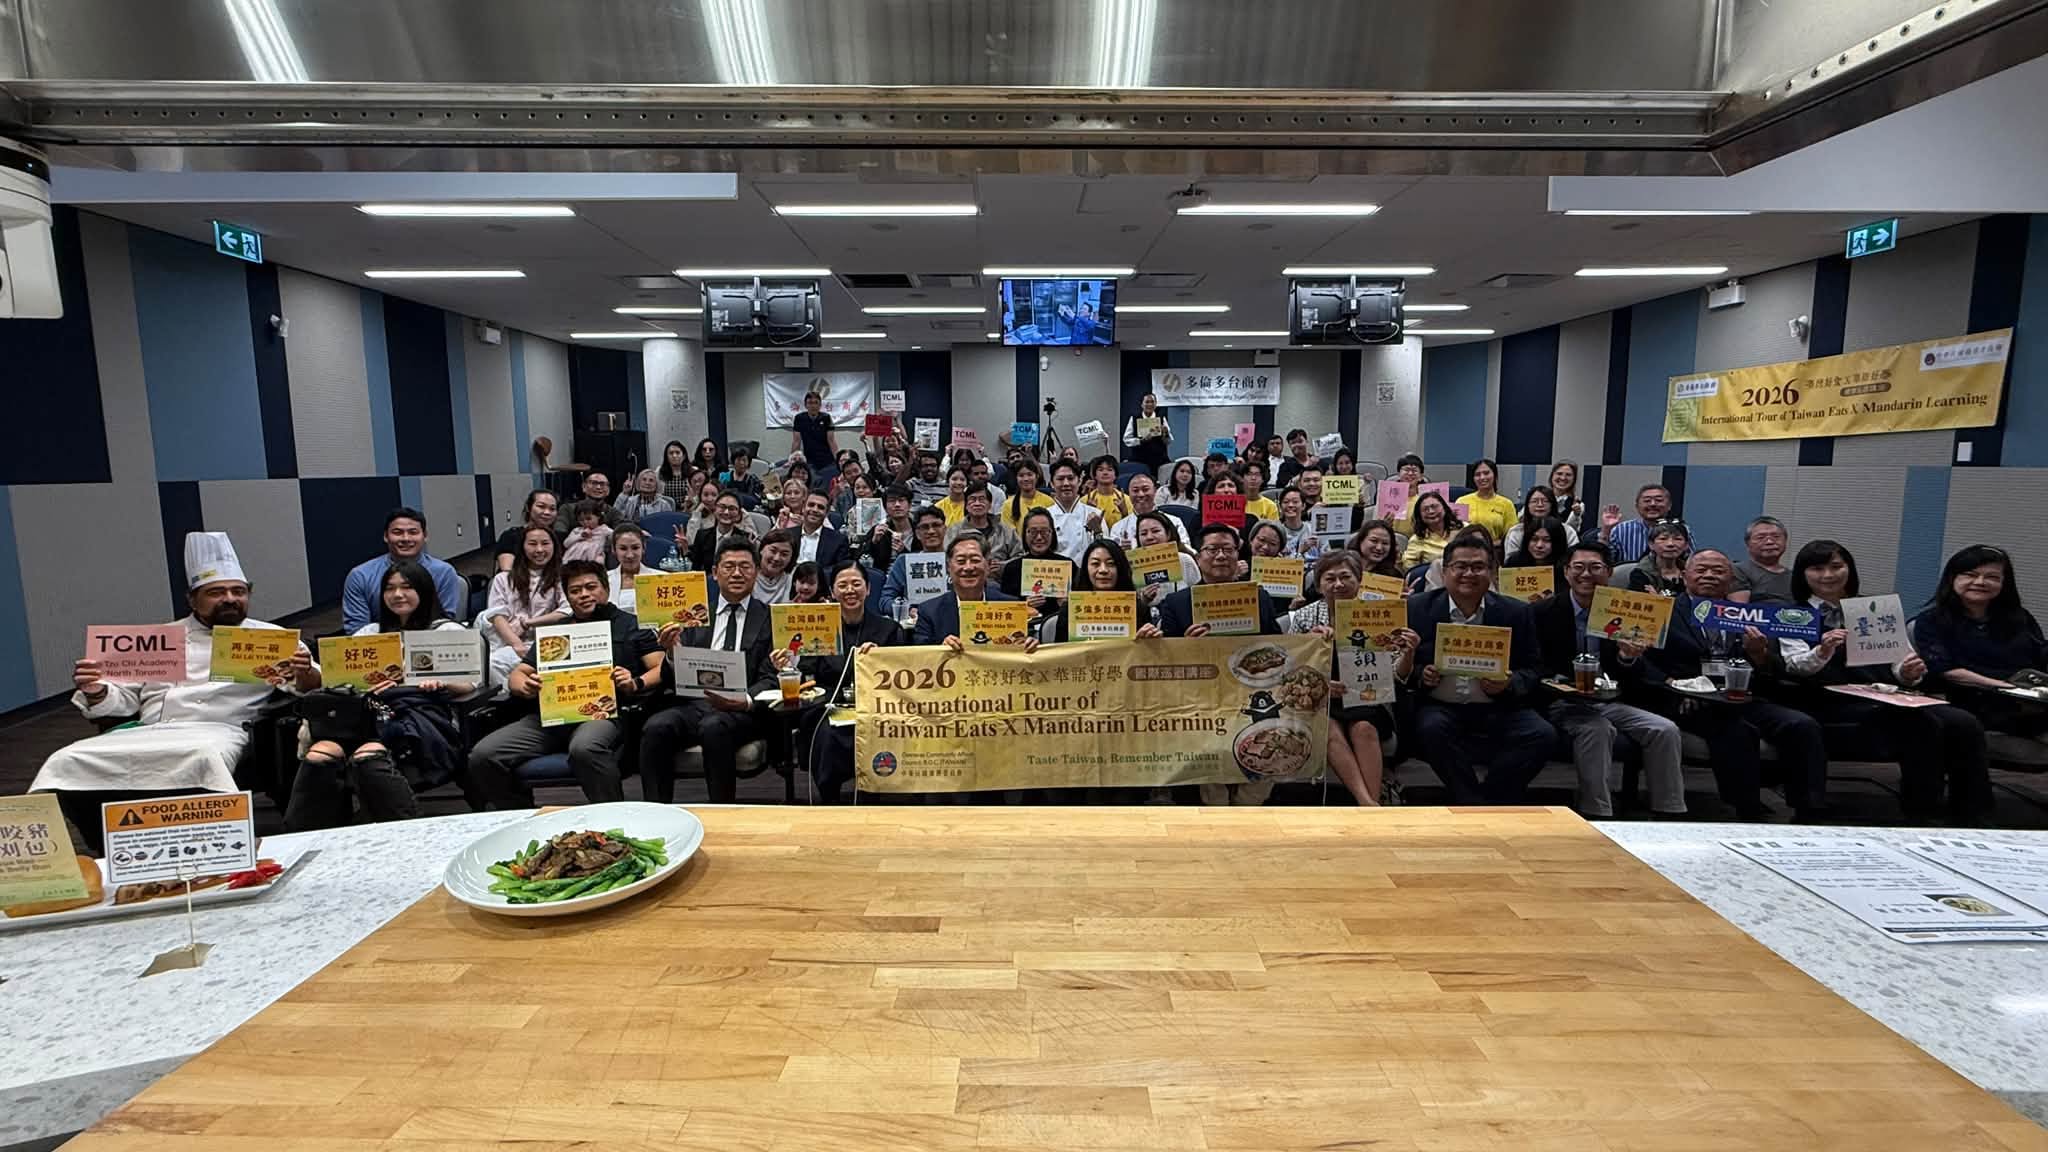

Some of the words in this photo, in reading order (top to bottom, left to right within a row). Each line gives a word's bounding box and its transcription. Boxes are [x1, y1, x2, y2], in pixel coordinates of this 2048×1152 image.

[1185, 375, 1268, 389] 多倫多台商會
[882, 393, 902, 401] TCML
[1741, 378, 1800, 407] 2026
[1701, 411, 1754, 425] International
[1756, 411, 1778, 423] Tour
[1779, 411, 1788, 421] of
[1791, 408, 1826, 422] Taiwan
[1828, 406, 1849, 418] Eats
[1850, 404, 1859, 415] X
[1862, 397, 1923, 414] Mandarin
[1926, 391, 1988, 411] Learning
[954, 430, 977, 439] TCML
[1077, 423, 1099, 434] TCML
[1210, 441, 1233, 449] TCML
[1325, 479, 1355, 489] TCML
[1207, 499, 1241, 511] TCML
[910, 561, 943, 579] 喜歡
[1146, 571, 1167, 581] TCML
[1516, 576, 1538, 586] 好吃
[657, 585, 686, 600] 好吃
[1074, 605, 1132, 614] 多倫多台商會
[1610, 598, 1654, 612] 台灣最棒
[787, 614, 826, 624] 台灣最棒
[976, 610, 1013, 620] 台灣好食
[1352, 610, 1391, 618] 台灣好食
[1713, 604, 1770, 623] TCML
[1854, 614, 1897, 637] 臺灣
[95, 634, 177, 653] TCML
[232, 642, 280, 653] 再來一碗
[344, 648, 378, 662] 好吃
[138, 658, 178, 667] Academy
[106, 669, 132, 677] North
[135, 668, 167, 677] Toronto
[873, 658, 956, 691] 2026
[557, 681, 599, 694] 再來一碗
[875, 693, 1013, 715] International
[1019, 691, 1072, 711] Tour
[1077, 689, 1100, 709] of
[875, 719, 947, 739] Taiwan
[954, 718, 998, 739] Eats
[1003, 717, 1019, 736] X
[1023, 715, 1125, 736] Mandarin
[1132, 712, 1228, 736] Learning
[1027, 753, 1059, 765] Taste
[1061, 752, 1107, 765] Taiwan,
[1110, 750, 1172, 763] Remember
[1175, 750, 1219, 762] Taiwan
[142, 804, 178, 815] FOOD
[181, 798, 240, 811] ALLERGY
[160, 809, 225, 823] WARNING
